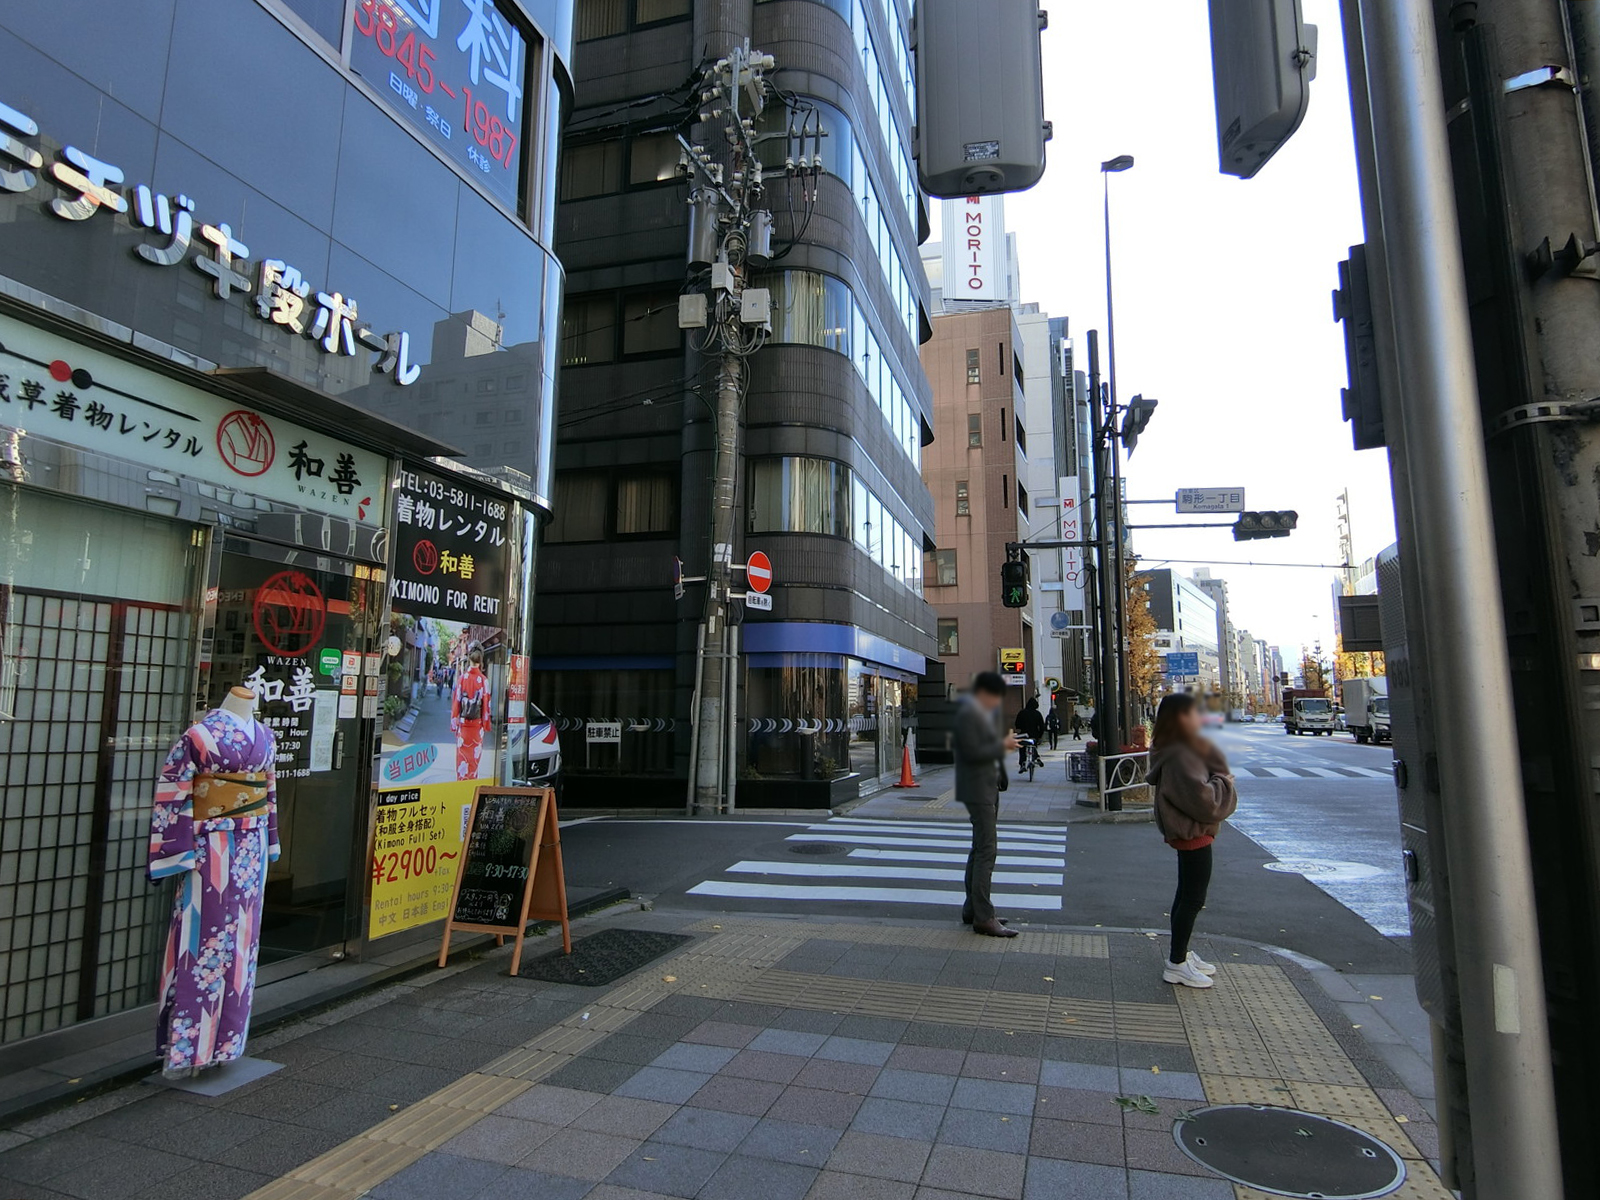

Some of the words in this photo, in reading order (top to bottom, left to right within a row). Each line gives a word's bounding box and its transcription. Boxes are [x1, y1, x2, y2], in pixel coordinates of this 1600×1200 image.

[395, 0, 522, 123] 科
[966, 212, 983, 290] MORITO
[288, 440, 362, 495] 和善
[298, 484, 350, 505] WAZEN
[1182, 493, 1240, 504] 駒形一丁目
[397, 492, 506, 547] 着物レンタル
[1063, 520, 1078, 581] MOITO
[440, 550, 475, 580] 和善
[391, 578, 440, 605] KIMONO
[446, 589, 468, 610] FOR
[473, 594, 500, 615] RENT
[267, 655, 307, 666] WAZEN
[1016, 663, 1023, 671] P
[244, 665, 320, 713] 和善
[290, 728, 309, 737] Hour
[588, 727, 619, 738] 駐車禁止
[386, 794, 398, 804] day
[401, 791, 419, 803] price
[376, 802, 446, 822] 着物フルセット
[408, 832, 425, 845] Full
[429, 828, 445, 841] Set)
[375, 896, 403, 910] Rental
[407, 889, 429, 901] hours
[378, 913, 397, 926] 中文
[402, 904, 428, 920] 日本語
